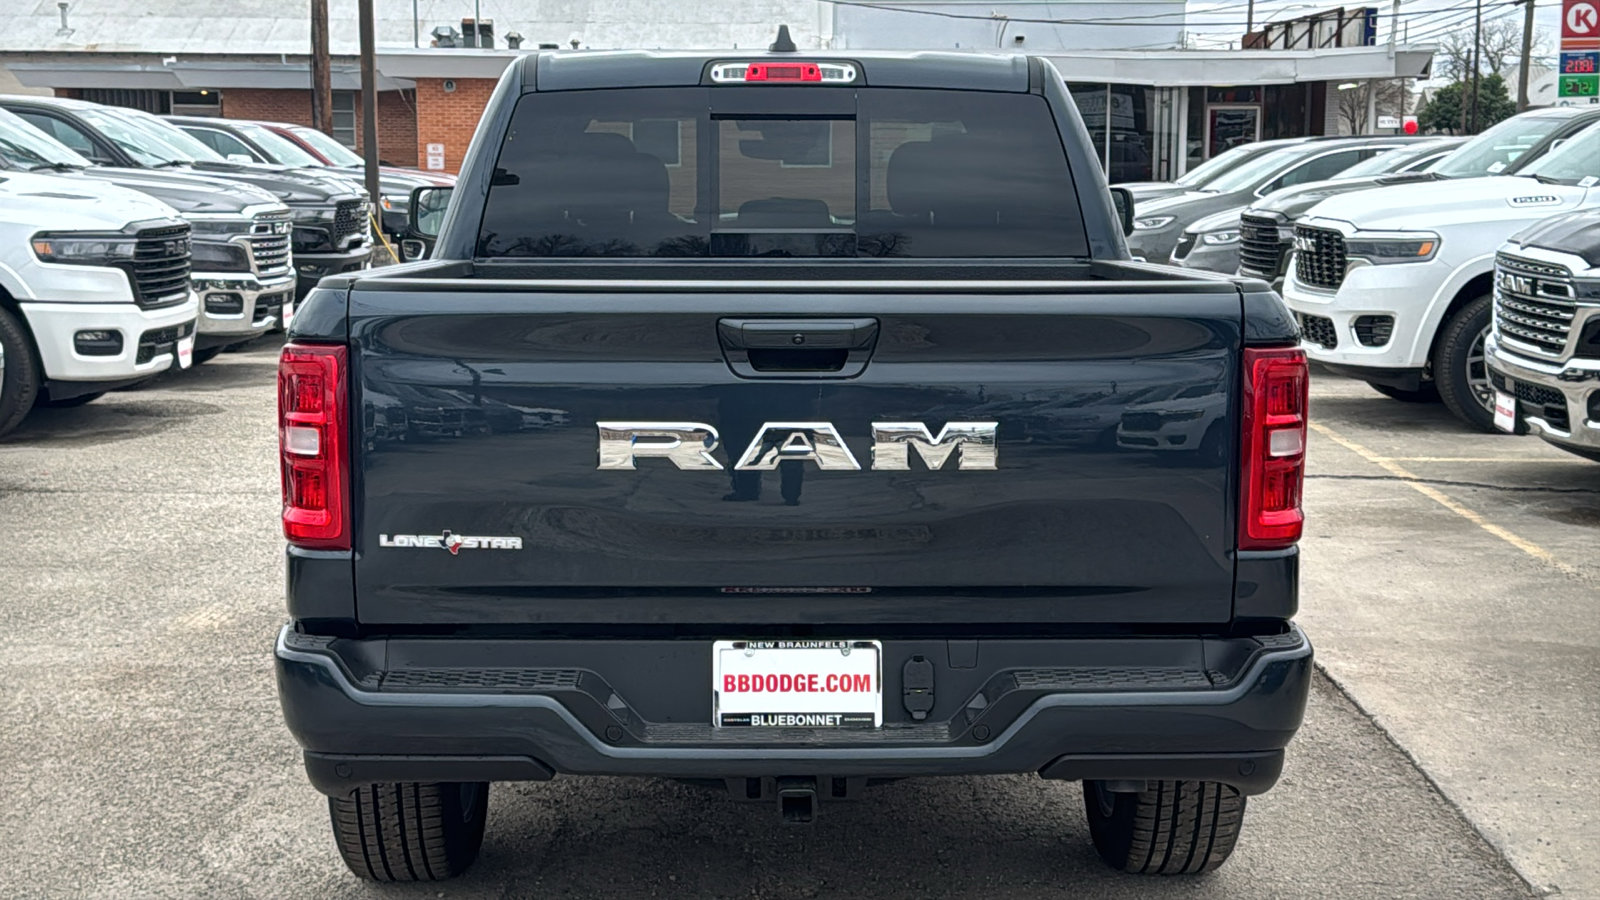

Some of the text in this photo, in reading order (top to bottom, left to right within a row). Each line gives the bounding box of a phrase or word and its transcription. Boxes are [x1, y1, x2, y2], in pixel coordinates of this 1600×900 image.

[1575, 9, 1597, 33] K
[596, 421, 999, 470] RAM
[379, 534, 523, 549] LONE STAR
[750, 641, 848, 649] NEW BRAUNFELS
[723, 674, 871, 693] BBDODGE.COM
[751, 714, 842, 726] BLUEBONNET
